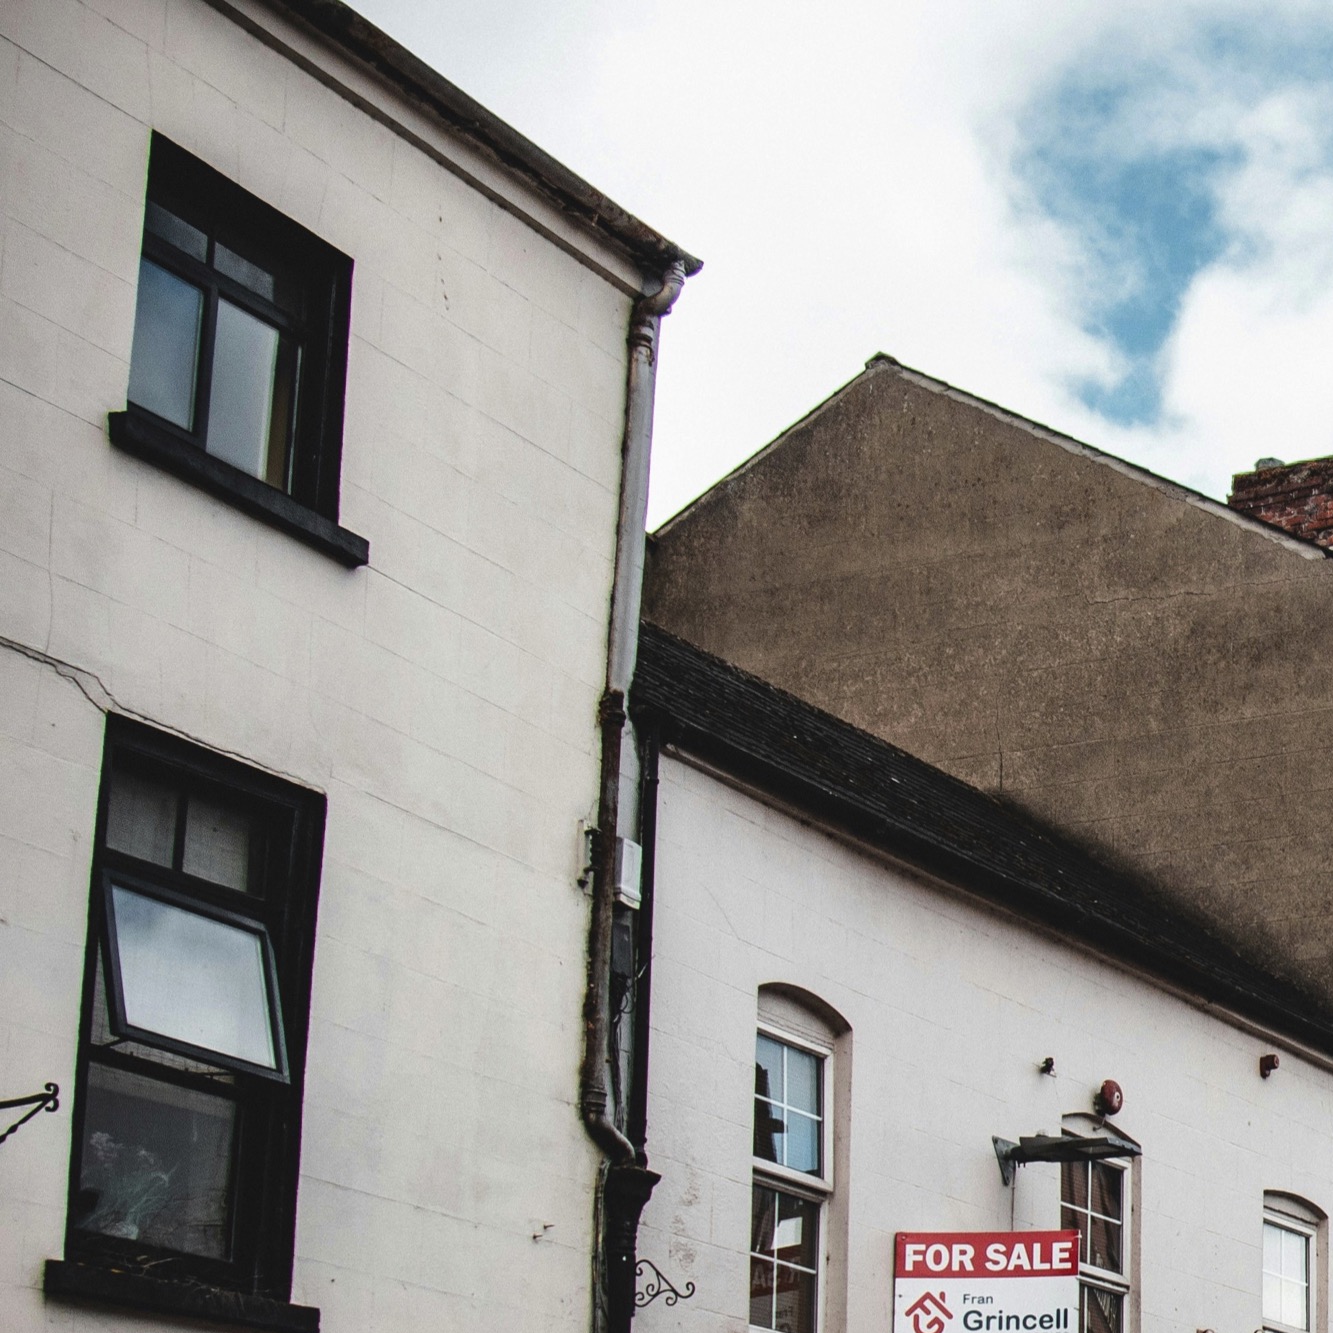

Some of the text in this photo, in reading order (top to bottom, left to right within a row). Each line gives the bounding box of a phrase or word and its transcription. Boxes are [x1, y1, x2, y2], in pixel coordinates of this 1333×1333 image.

[904, 1241, 1073, 1272] FOR SALE
[962, 1293, 994, 1305] Fran
[962, 1307, 1069, 1331] Grincell
